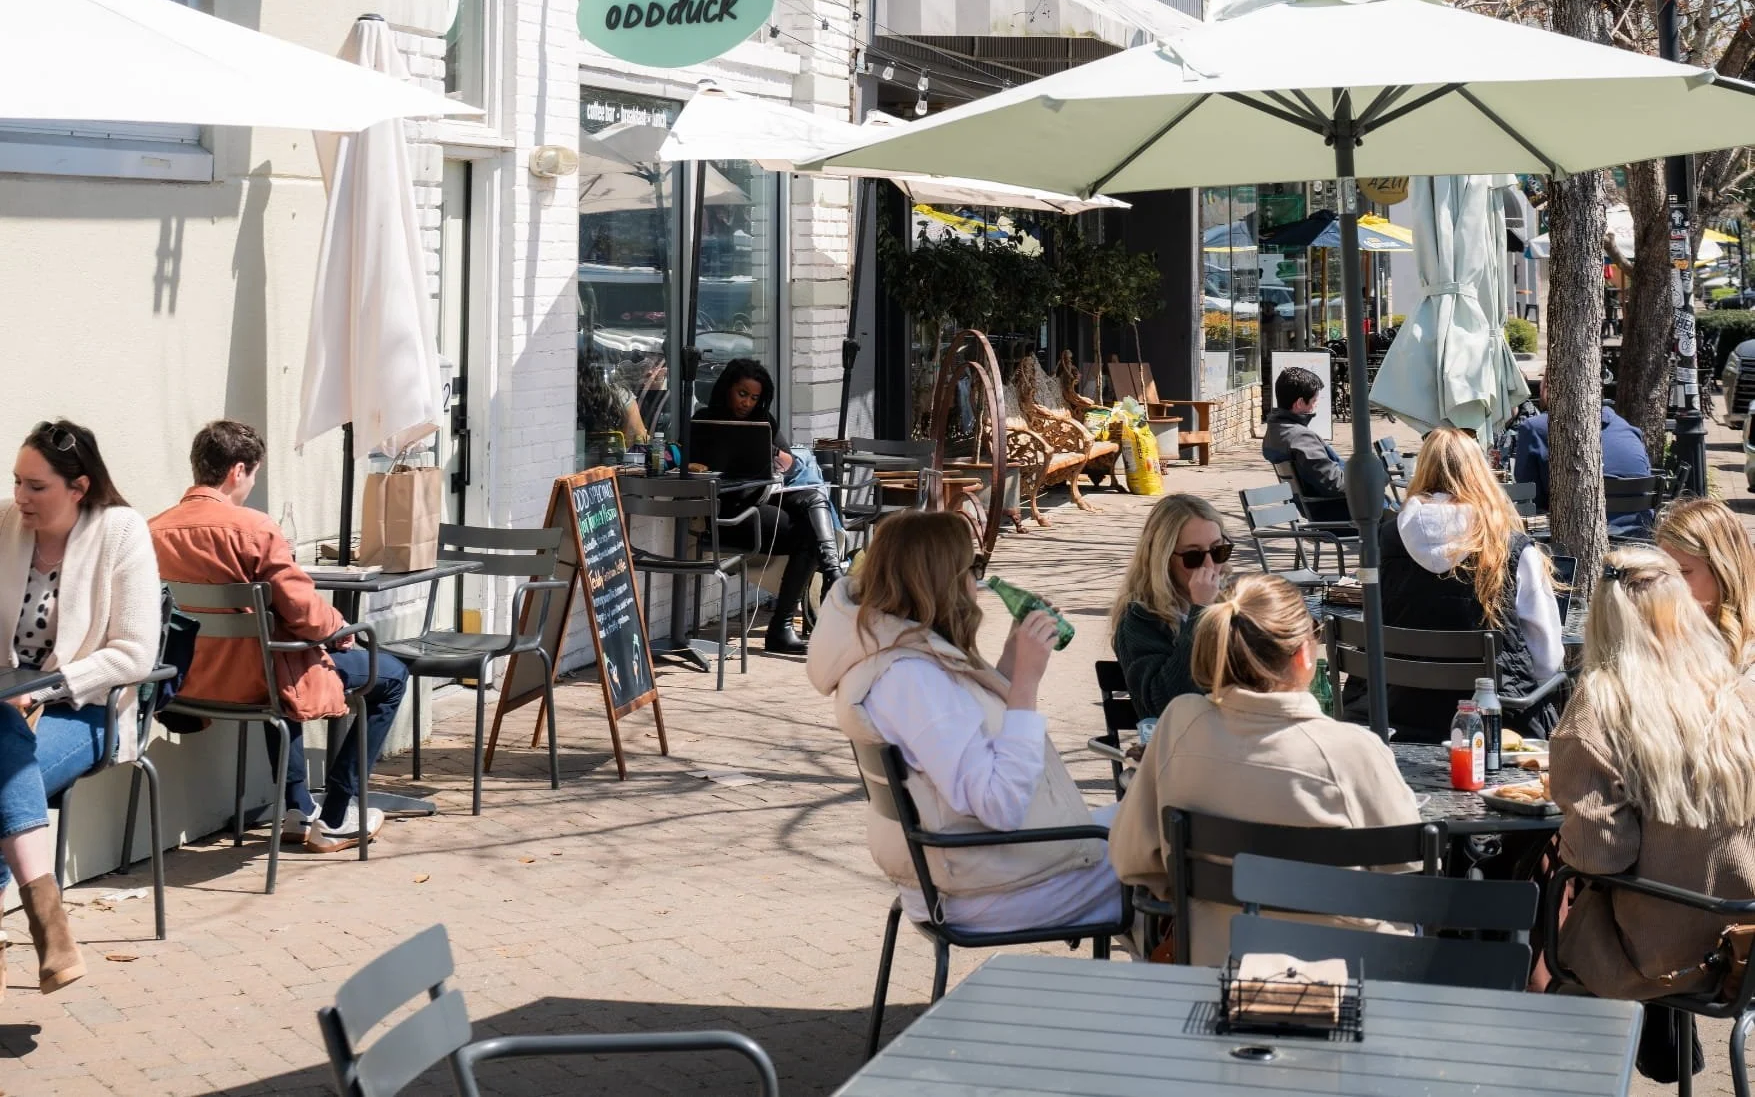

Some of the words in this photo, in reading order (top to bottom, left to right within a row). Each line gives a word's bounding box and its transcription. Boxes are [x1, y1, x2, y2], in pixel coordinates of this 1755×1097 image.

[587, 100, 604, 121] coffee
[605, 102, 615, 122] bar
[621, 104, 646, 126] breakfast
[652, 108, 667, 128] lunch
